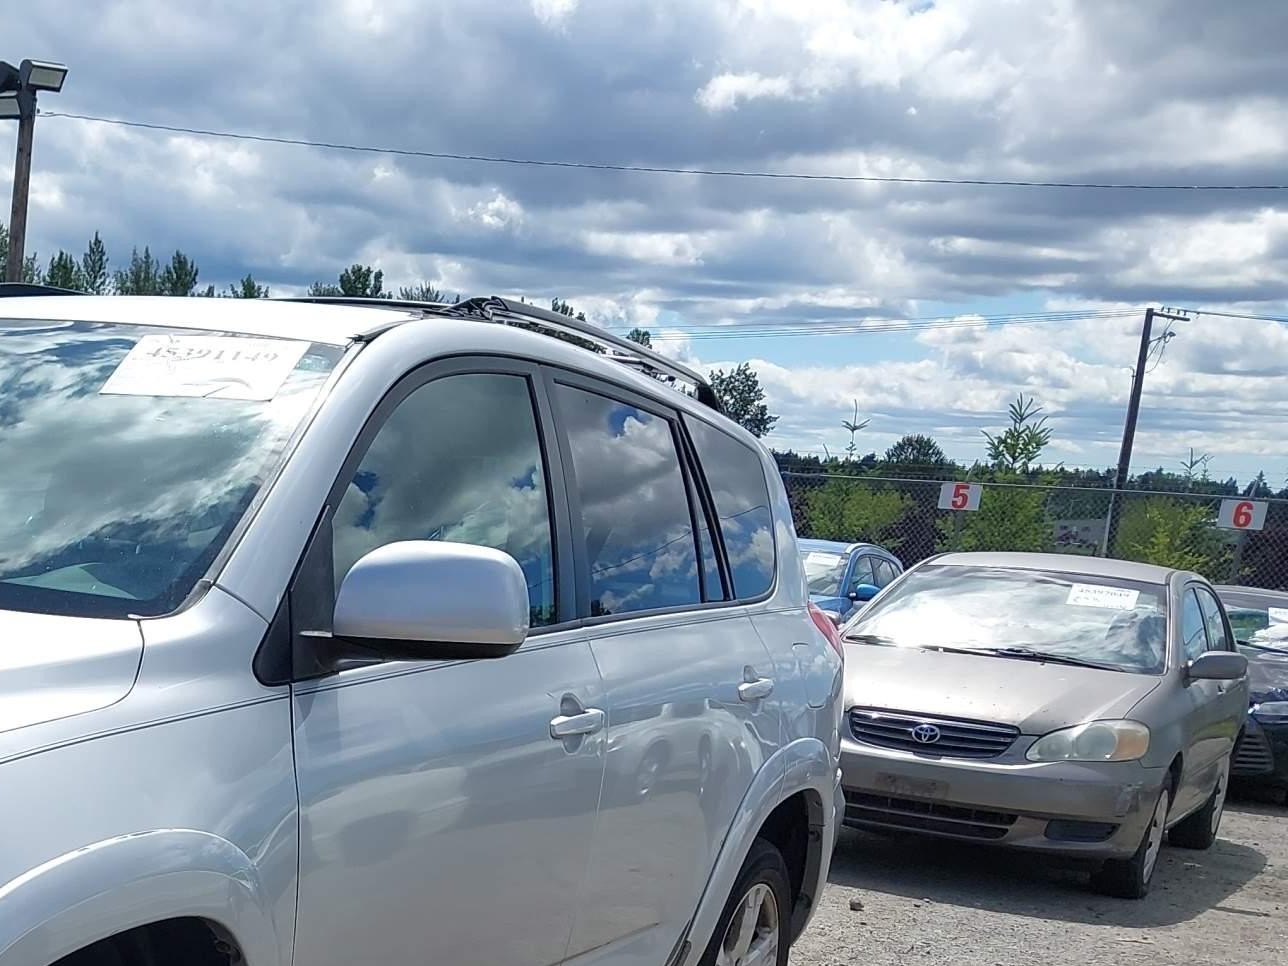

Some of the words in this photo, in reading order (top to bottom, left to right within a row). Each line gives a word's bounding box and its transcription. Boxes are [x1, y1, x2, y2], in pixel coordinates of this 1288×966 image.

[145, 346, 280, 363] 45391149
[952, 484, 970, 509] 5
[1233, 501, 1254, 528] 6
